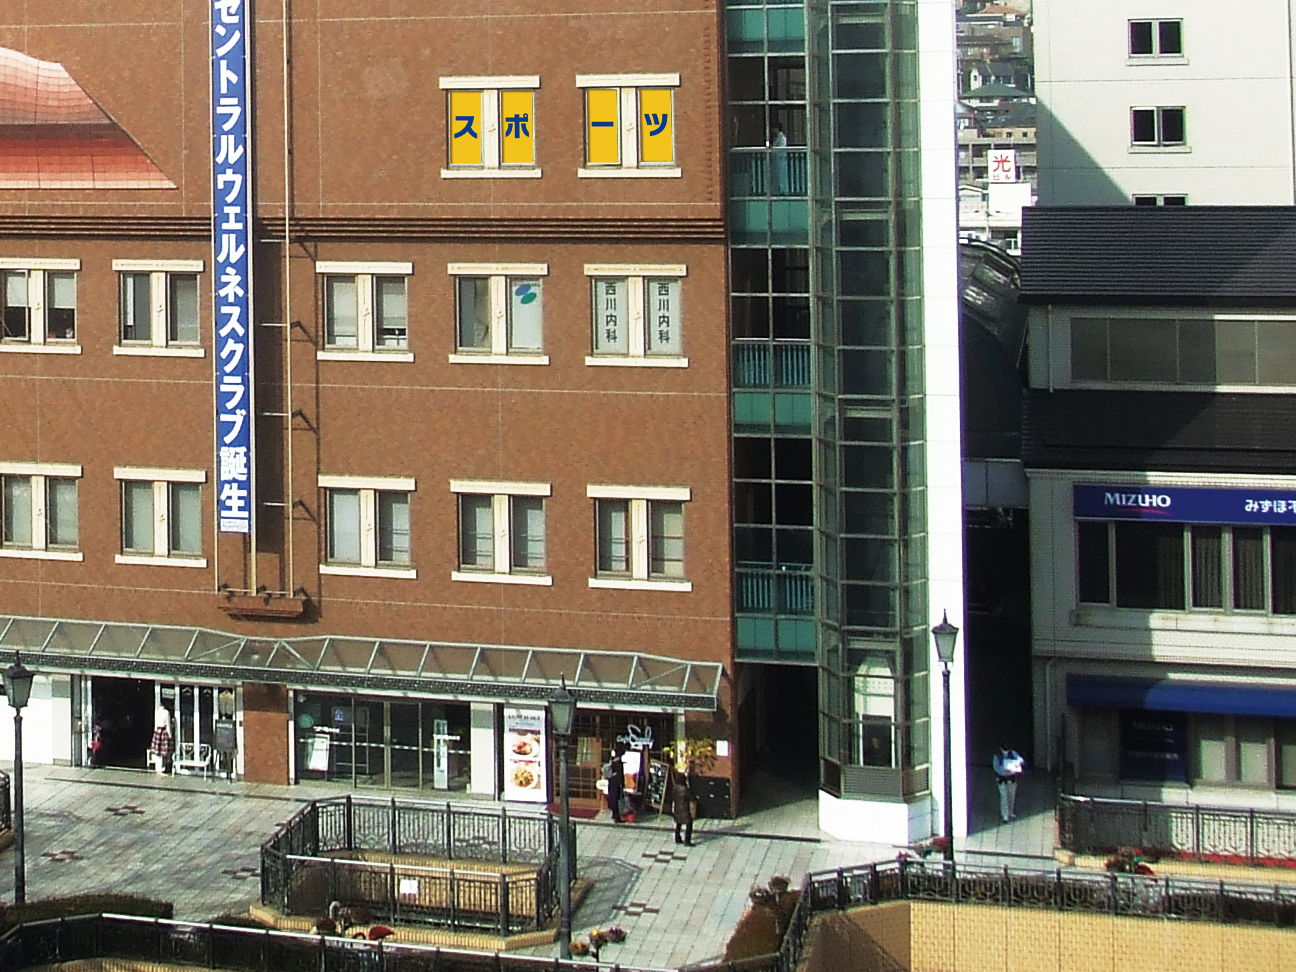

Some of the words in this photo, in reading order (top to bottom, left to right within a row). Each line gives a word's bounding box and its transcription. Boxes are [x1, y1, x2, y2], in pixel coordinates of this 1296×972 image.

[605, 282, 617, 343] 西川内科
[658, 282, 670, 344] 西川内科
[1104, 492, 1171, 508] MIZUHO
